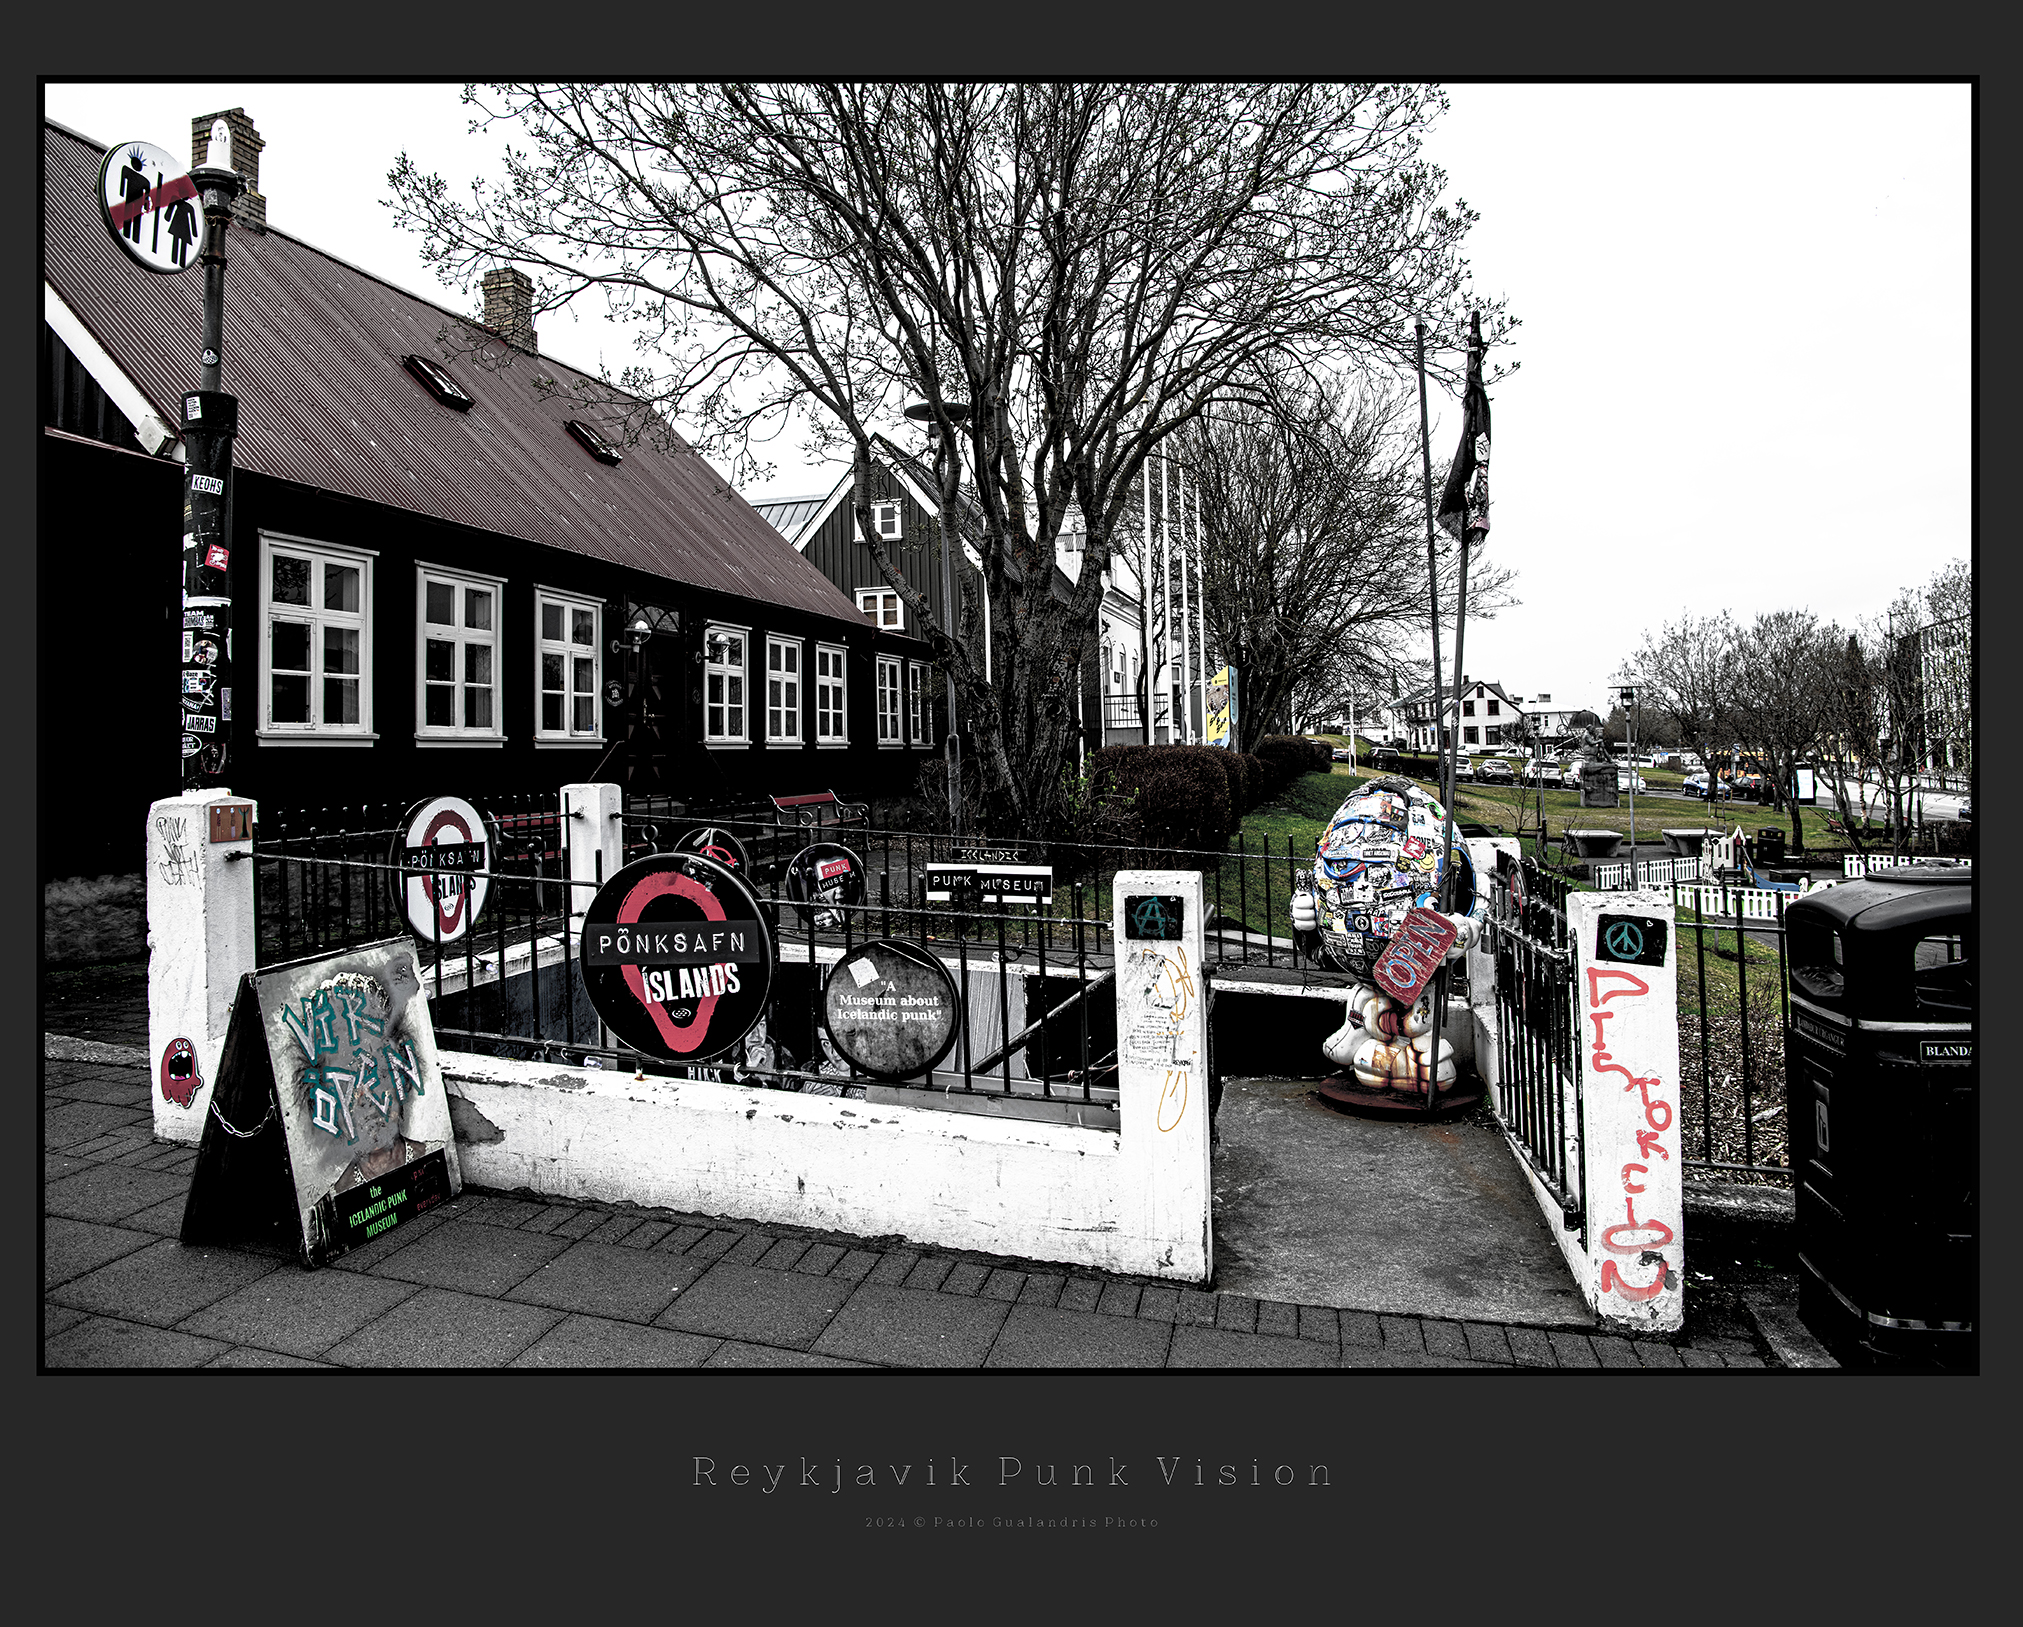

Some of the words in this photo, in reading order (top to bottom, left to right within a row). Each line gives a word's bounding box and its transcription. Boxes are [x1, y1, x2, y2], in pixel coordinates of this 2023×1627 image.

[192, 475, 223, 494] KEOHS
[186, 716, 215, 732] JARRAS
[824, 863, 848, 876] PUNK
[822, 871, 857, 889] MUSEM
[599, 928, 745, 954] PÖNKSAFN
[1386, 913, 1447, 988] OPEN
[641, 962, 741, 1004] ÍSLANDS
[839, 994, 897, 1006] Museum
[900, 994, 940, 1006] about
[837, 1008, 898, 1020] Icelandic
[901, 1009, 942, 1022] punk"
[369, 1185, 382, 1199] the
[349, 1200, 387, 1228] ICELANDIC
[387, 1189, 408, 1209] PUNK
[366, 1212, 398, 1238] MUSEUM
